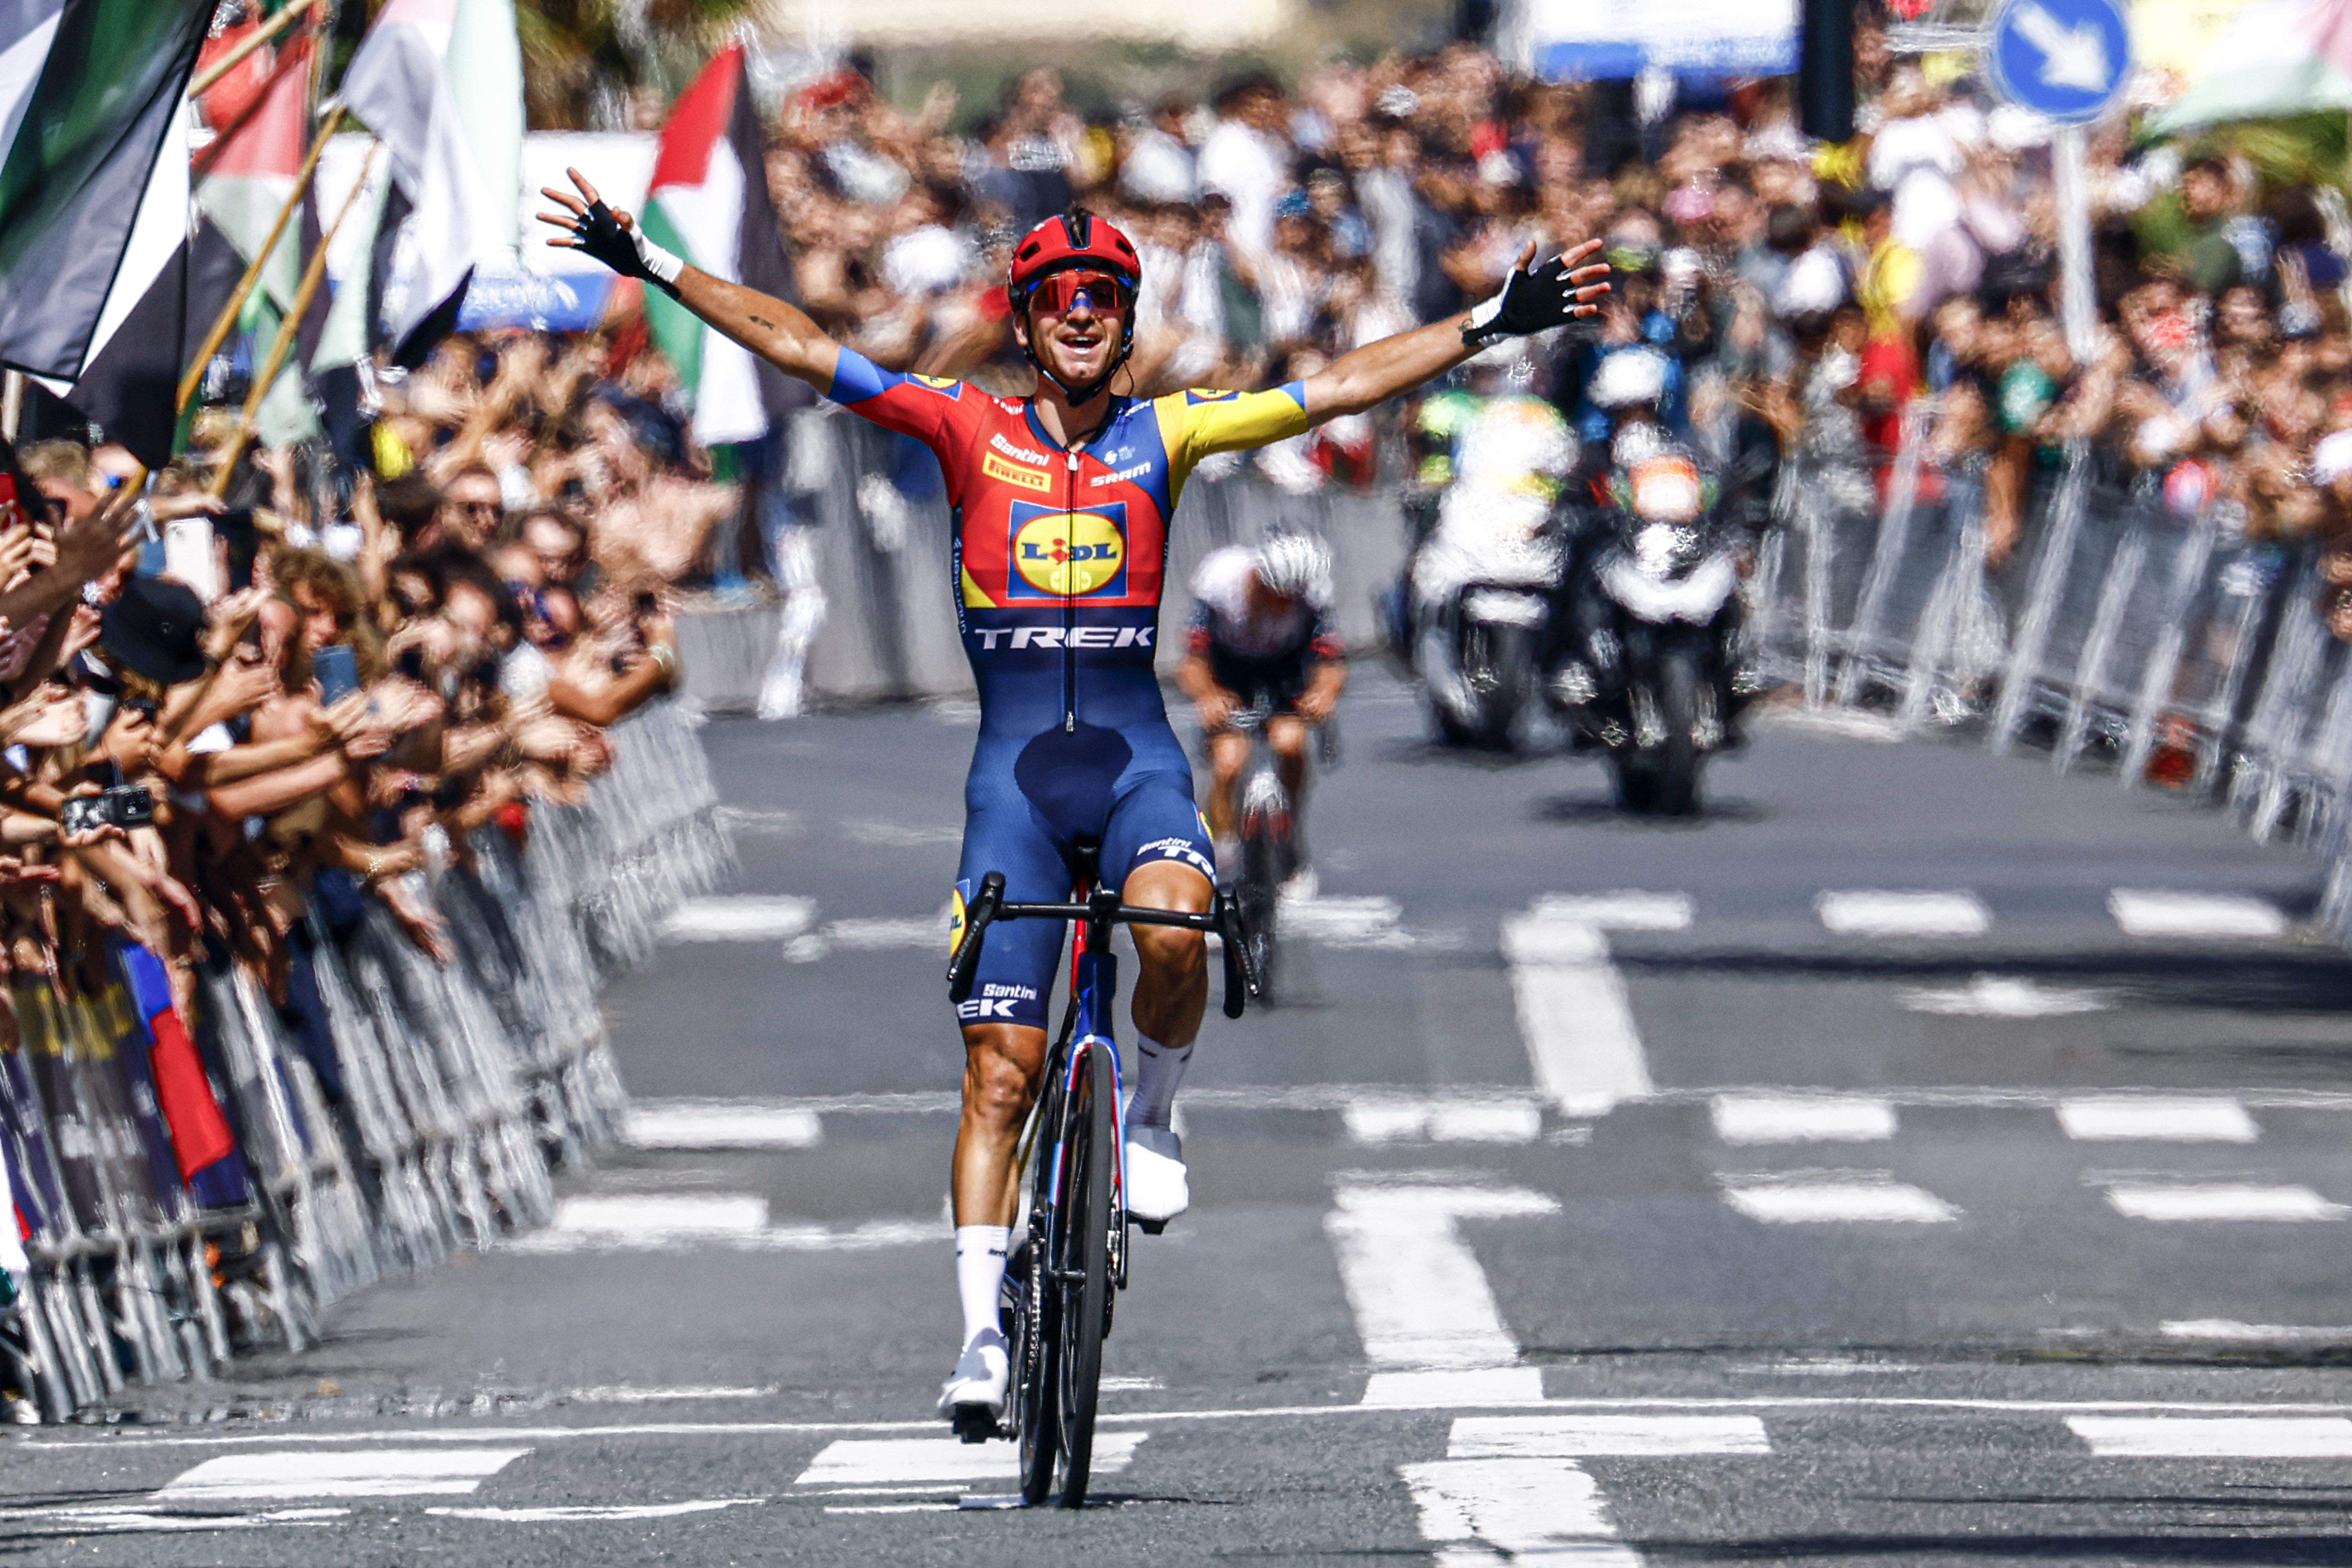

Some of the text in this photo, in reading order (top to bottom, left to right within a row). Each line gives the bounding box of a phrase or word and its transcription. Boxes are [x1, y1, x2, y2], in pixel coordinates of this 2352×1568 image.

[990, 433, 1050, 466] Santini
[989, 458, 1045, 487] PIRELLI
[1090, 461, 1151, 487] SRAM
[974, 626, 1155, 650] TREK
[1137, 837, 1192, 856] Santini
[983, 983, 1038, 1000] Santini
